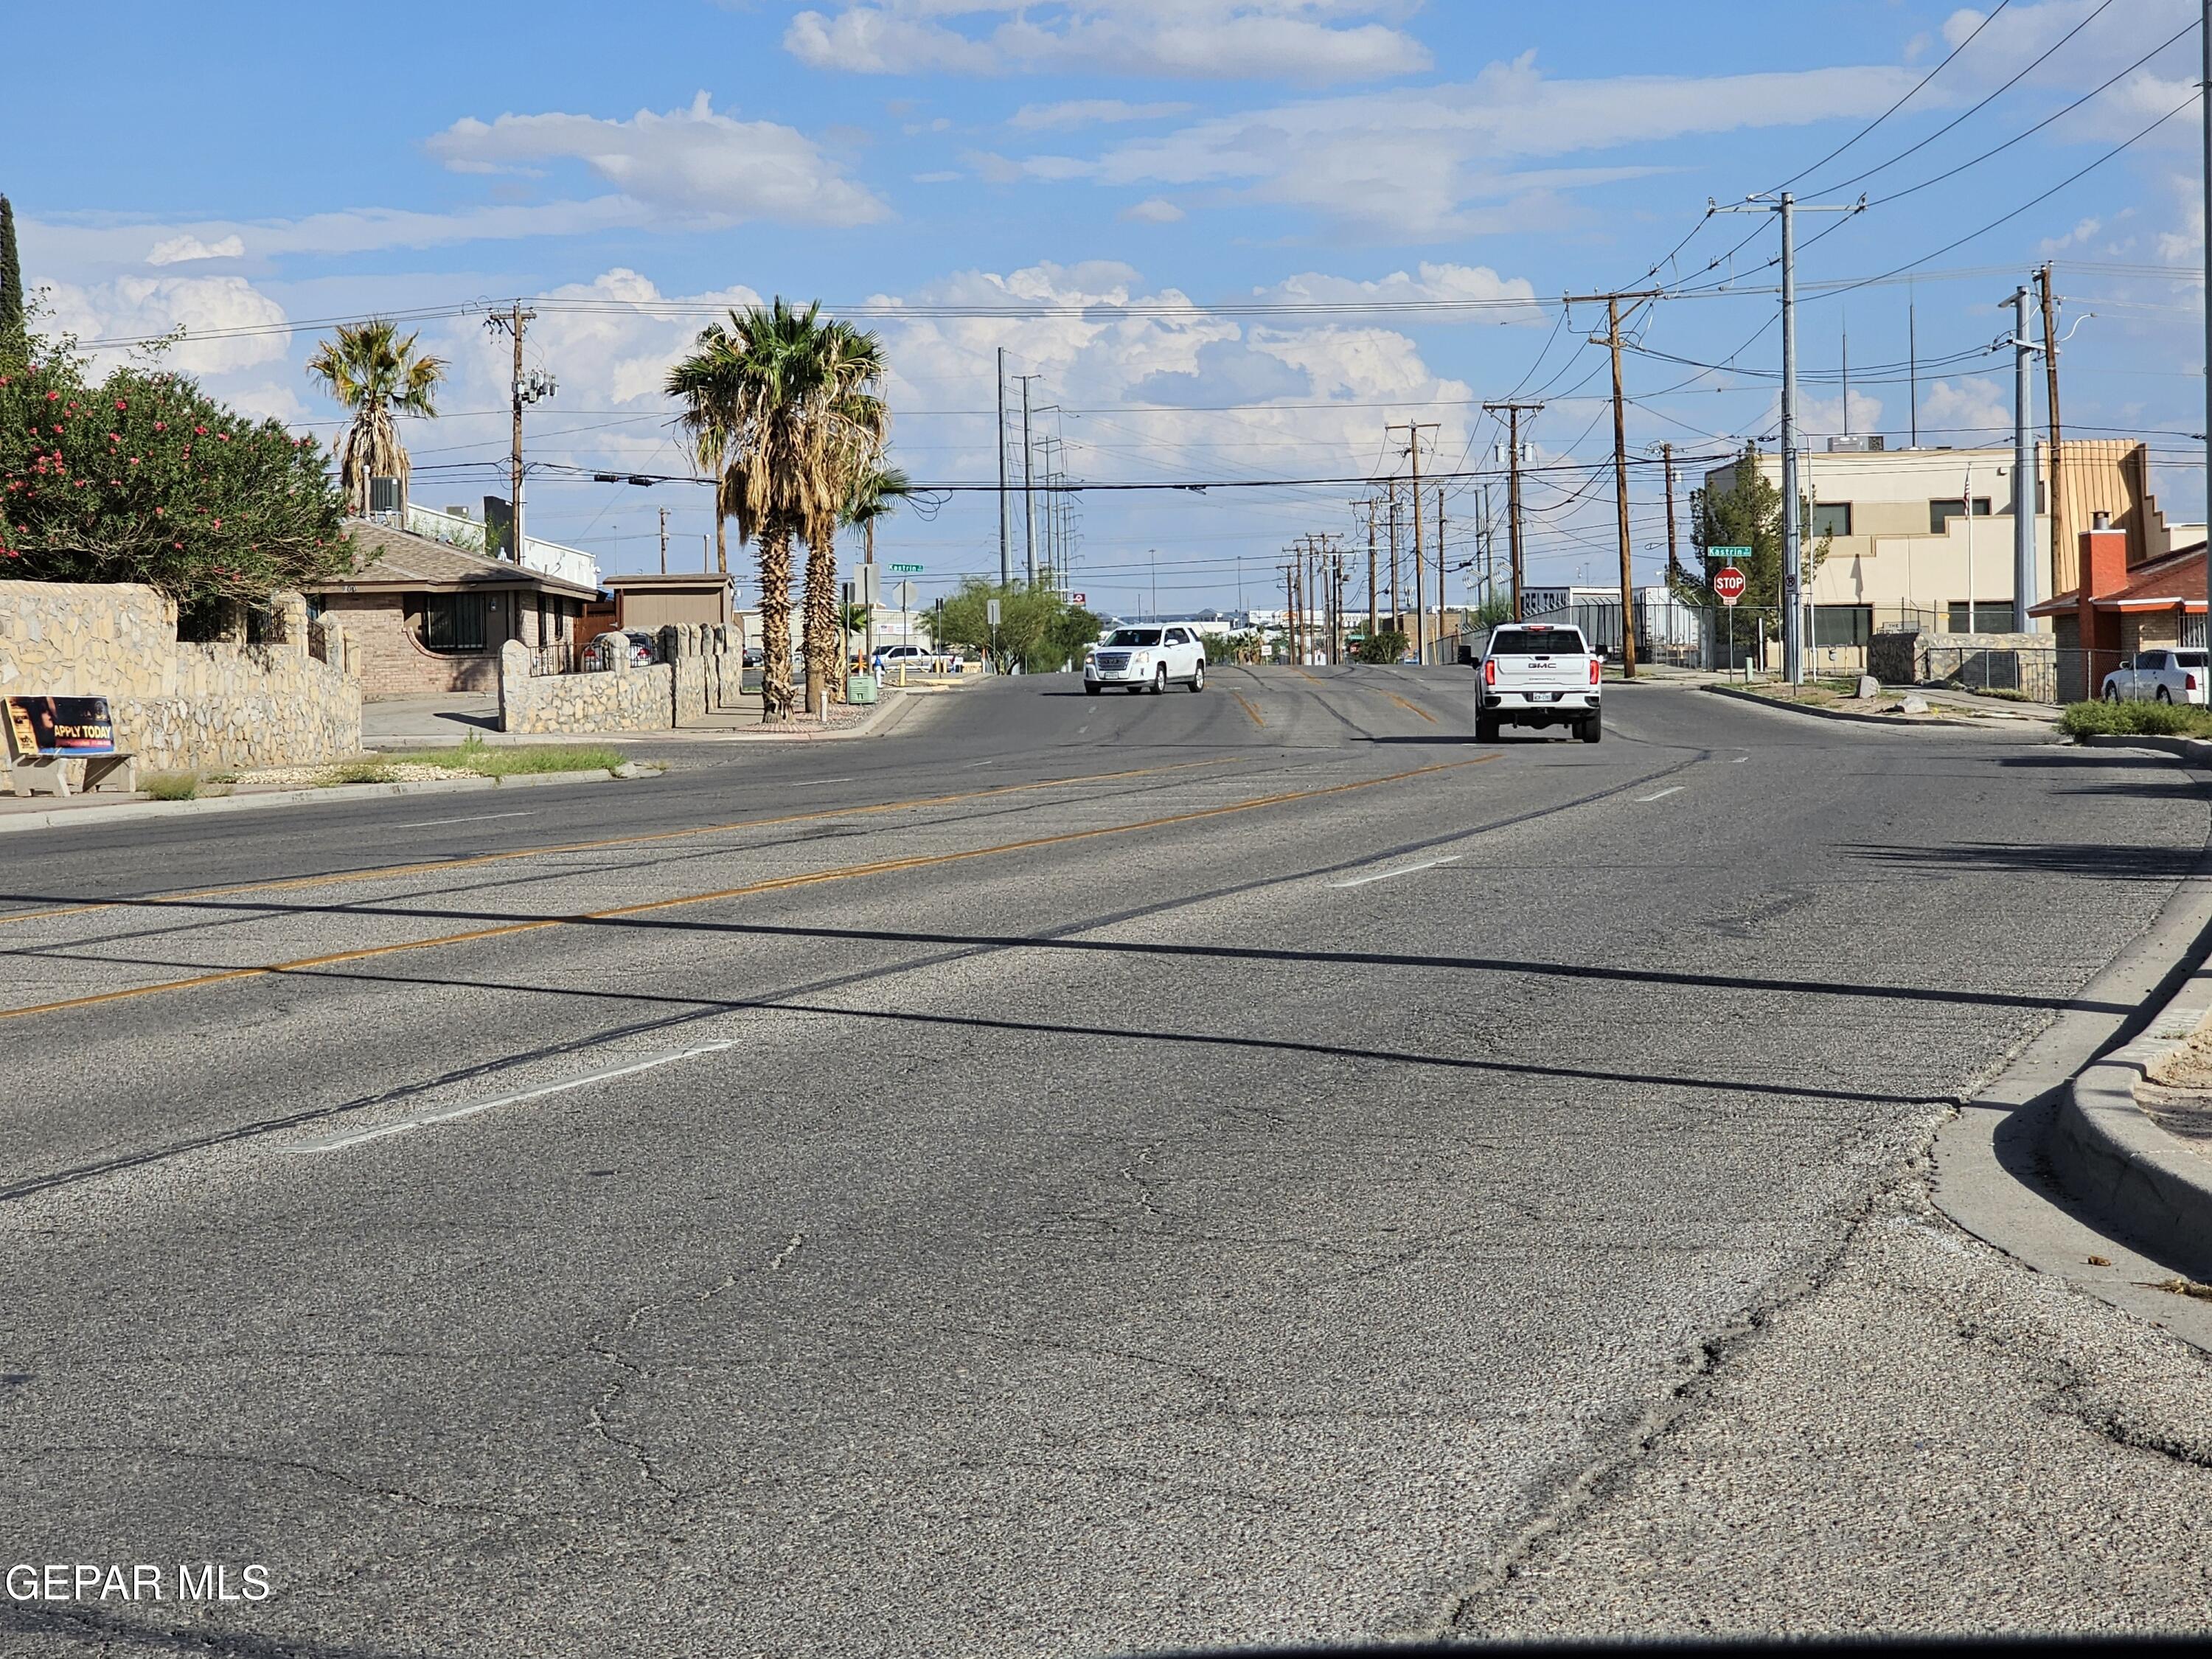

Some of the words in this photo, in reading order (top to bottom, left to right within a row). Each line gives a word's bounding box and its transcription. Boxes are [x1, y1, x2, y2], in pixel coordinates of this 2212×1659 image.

[1709, 547, 1742, 555] Kastrin
[888, 563, 917, 571] Kastrin
[1717, 577, 1743, 589] STOP
[54, 725, 81, 737] APPLY
[82, 725, 111, 739] TODAY
